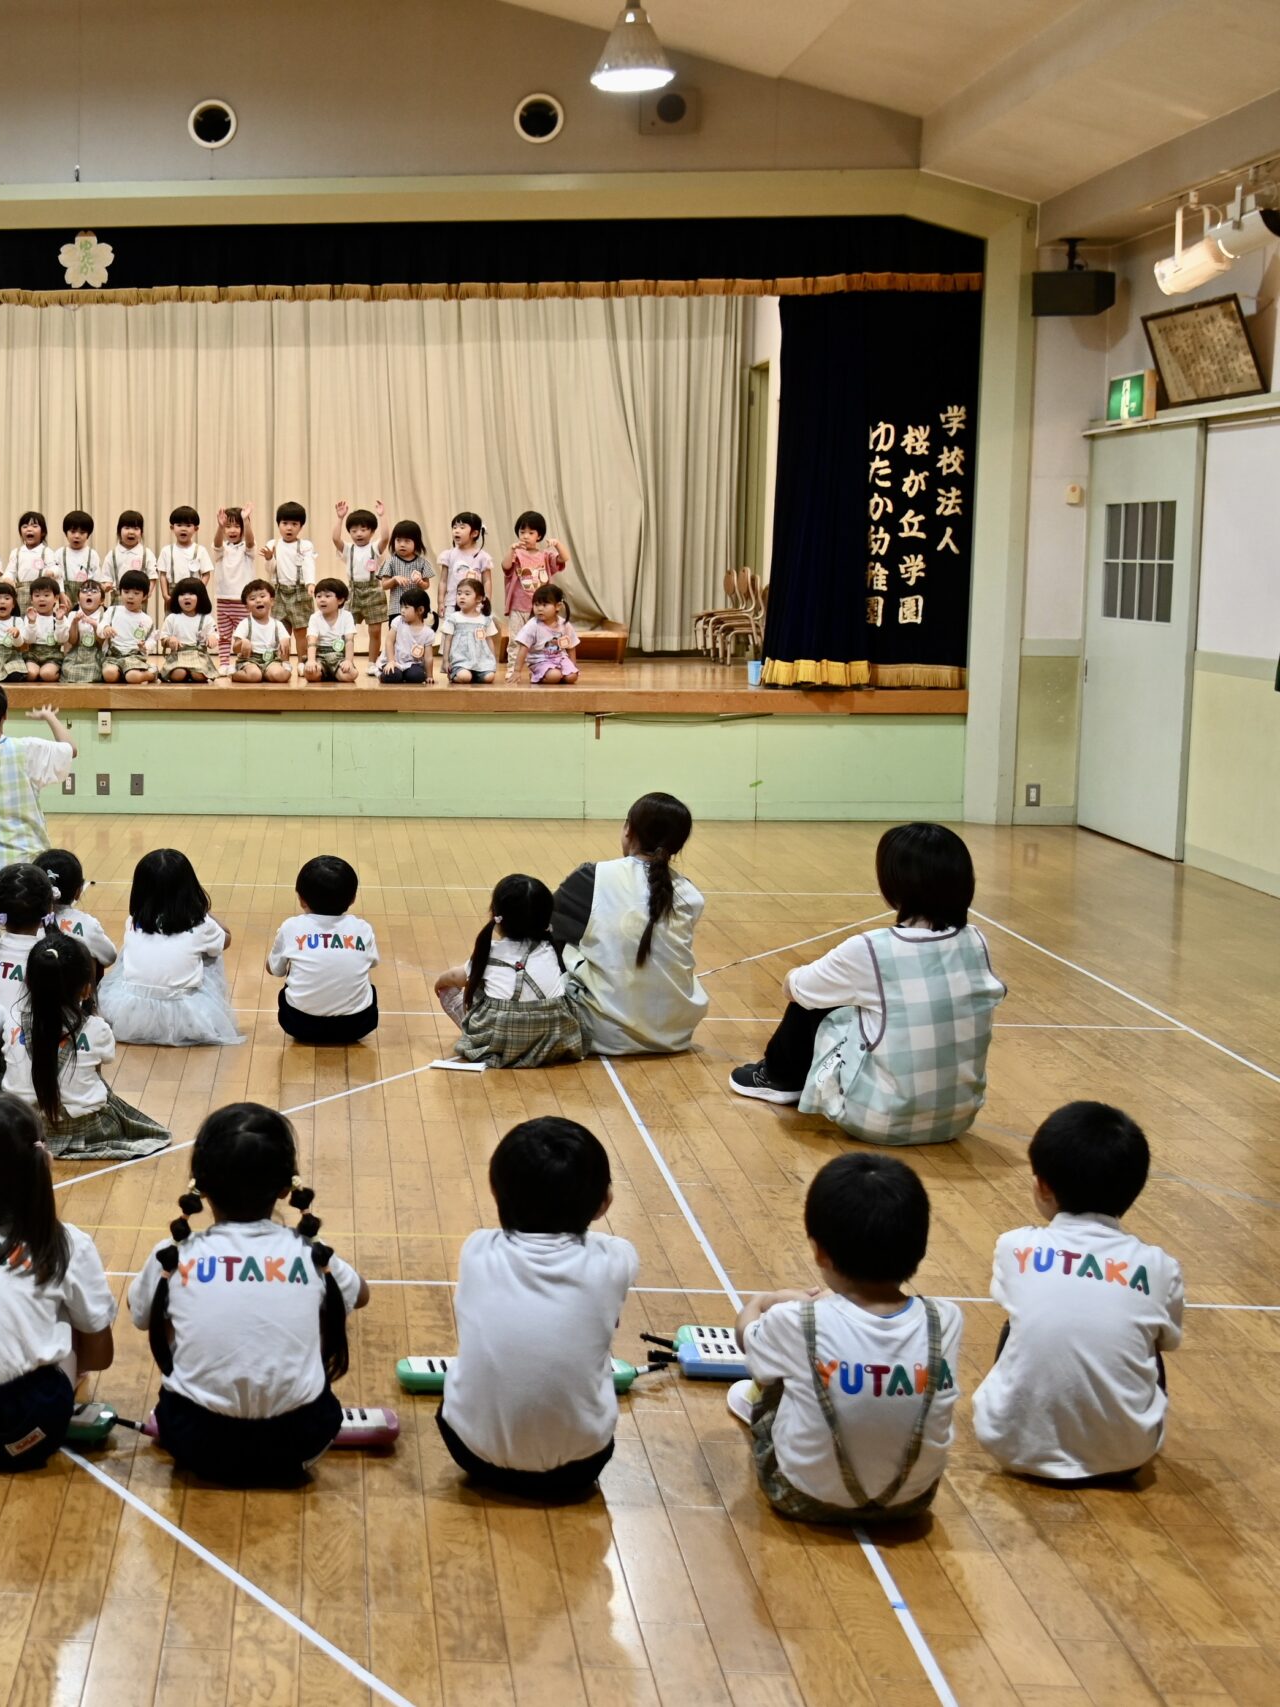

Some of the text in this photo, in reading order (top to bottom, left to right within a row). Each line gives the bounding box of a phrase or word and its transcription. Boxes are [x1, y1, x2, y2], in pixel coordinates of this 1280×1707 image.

[866, 420, 896, 628] ゆたか幼稚園
[898, 424, 931, 625] 桜が丘学園
[936, 404, 967, 555] 学校法人
[294, 933, 366, 952] YUTAKA
[178, 1255, 309, 1287] YUTAKA
[1013, 1246, 1151, 1296] YUTAKA
